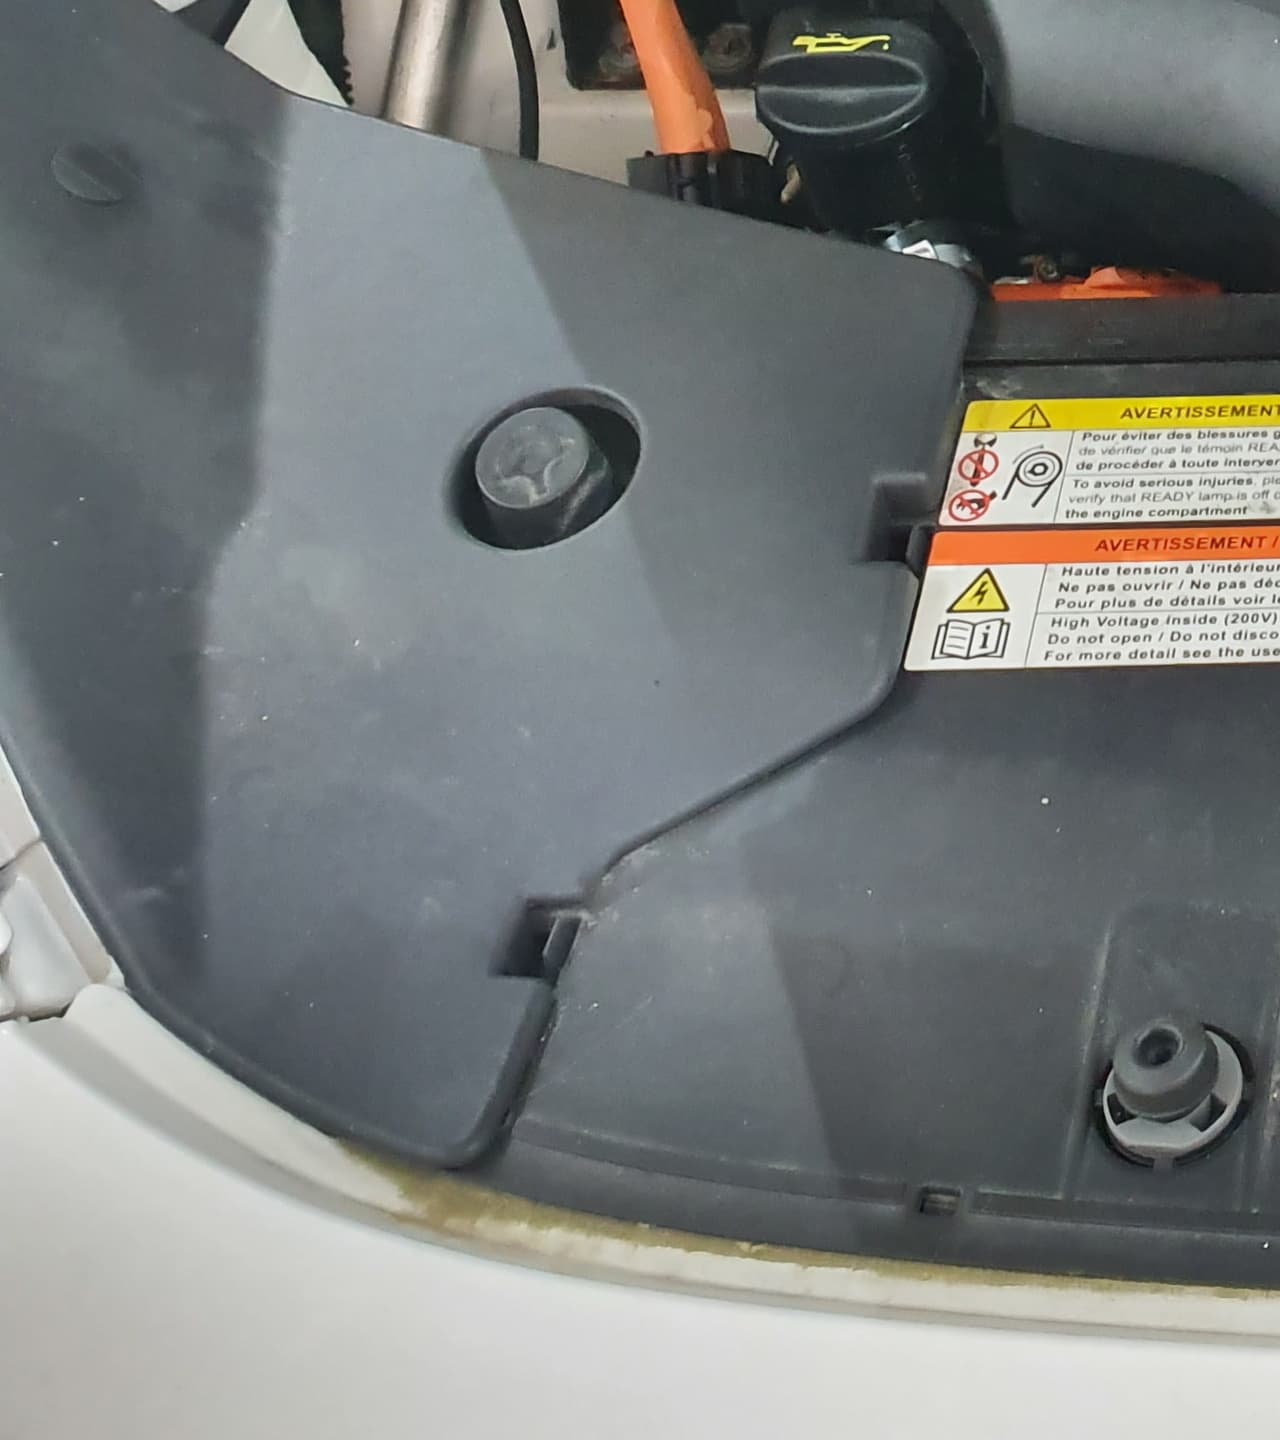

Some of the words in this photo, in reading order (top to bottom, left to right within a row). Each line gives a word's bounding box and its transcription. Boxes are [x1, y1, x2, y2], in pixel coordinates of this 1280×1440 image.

[1082, 431, 1116, 441] Pour
[1121, 430, 1161, 441] éviter
[1166, 430, 1192, 440] des
[1197, 429, 1268, 440] blessures
[1078, 446, 1096, 456] de
[1101, 445, 1147, 456] vérifier
[1150, 446, 1176, 457] que
[1181, 444, 1193, 455] le
[1076, 461, 1093, 471] de
[1098, 460, 1165, 472] procéder
[1181, 458, 1219, 469] toute
[1072, 479, 1089, 489] To
[1094, 478, 1134, 489] avoid
[1139, 478, 1193, 488] serious
[1068, 494, 1105, 506] verify
[1110, 493, 1136, 504] that
[1140, 492, 1194, 503] READY
[1252, 490, 1270, 500] off
[1065, 508, 1088, 519] the
[1093, 507, 1144, 520] engine
[1148, 505, 1247, 518] compartment
[1095, 536, 1267, 552] AVERTISSEMENT
[1061, 565, 1109, 577] Haute
[1116, 564, 1180, 576] tension
[1058, 582, 1080, 593] Ne
[1085, 583, 1116, 594] pas
[1122, 581, 1174, 592] ouvrir
[1190, 580, 1211, 591] Ne
[1216, 580, 1247, 592] pas
[1054, 598, 1095, 609] Pour
[1100, 597, 1137, 610] plus
[1143, 596, 1164, 607] de
[1169, 594, 1227, 607] détails
[1233, 594, 1266, 606] voir
[1051, 616, 1090, 630] High
[1097, 615, 1160, 629] Voltage
[1224, 612, 1279, 626] (200V)
[1048, 634, 1070, 645] Do
[1076, 633, 1105, 644] not
[1110, 633, 1152, 645] open
[1170, 631, 1193, 642] Do
[1199, 630, 1226, 641] not
[1044, 650, 1072, 661] For
[1078, 650, 1122, 661] more
[1128, 647, 1176, 660] detail
[1182, 648, 1212, 659] see
[1218, 646, 1245, 657] the
